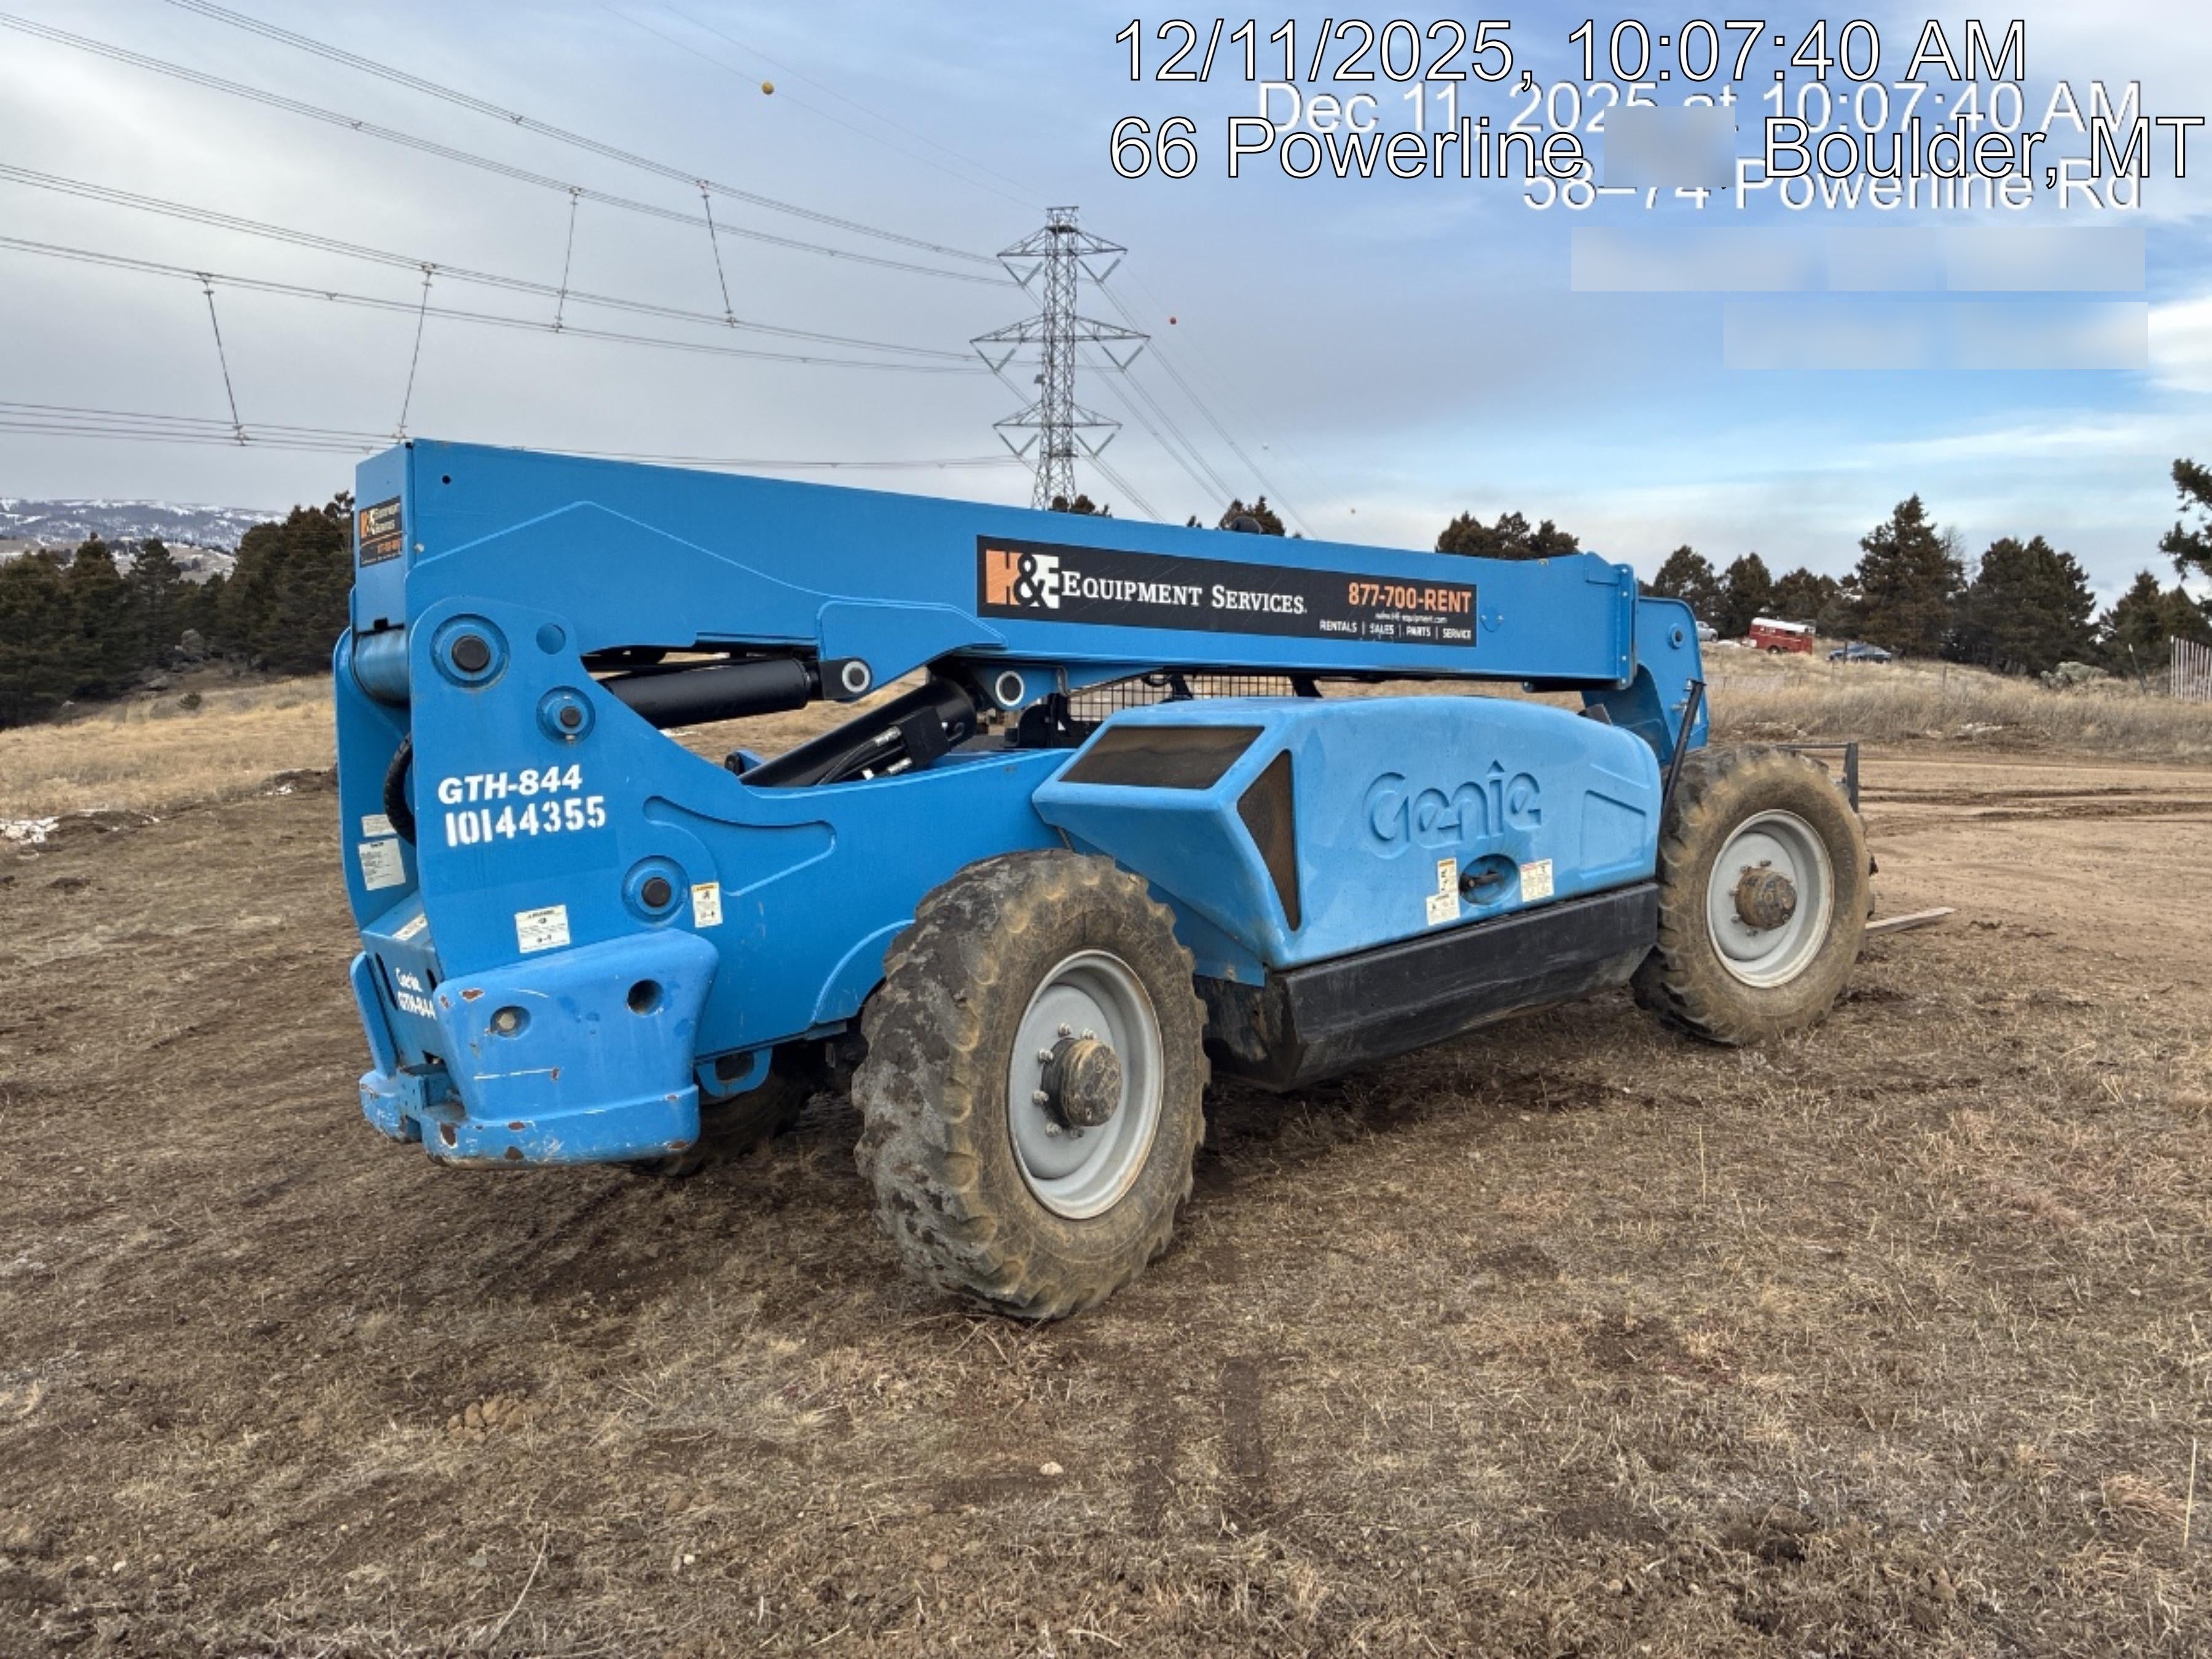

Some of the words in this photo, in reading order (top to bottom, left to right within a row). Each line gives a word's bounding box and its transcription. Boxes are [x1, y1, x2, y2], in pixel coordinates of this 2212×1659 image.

[1348, 582, 1472, 613] 877-700-RENT
[1319, 619, 1358, 633] RENTALS
[1369, 622, 1395, 635] SALES
[1406, 626, 1432, 637] PARTS
[1443, 628, 1472, 640] SERVICE
[438, 764, 583, 805] GTH-844
[445, 796, 606, 847] 10144355
[1362, 759, 1543, 859] Genie
